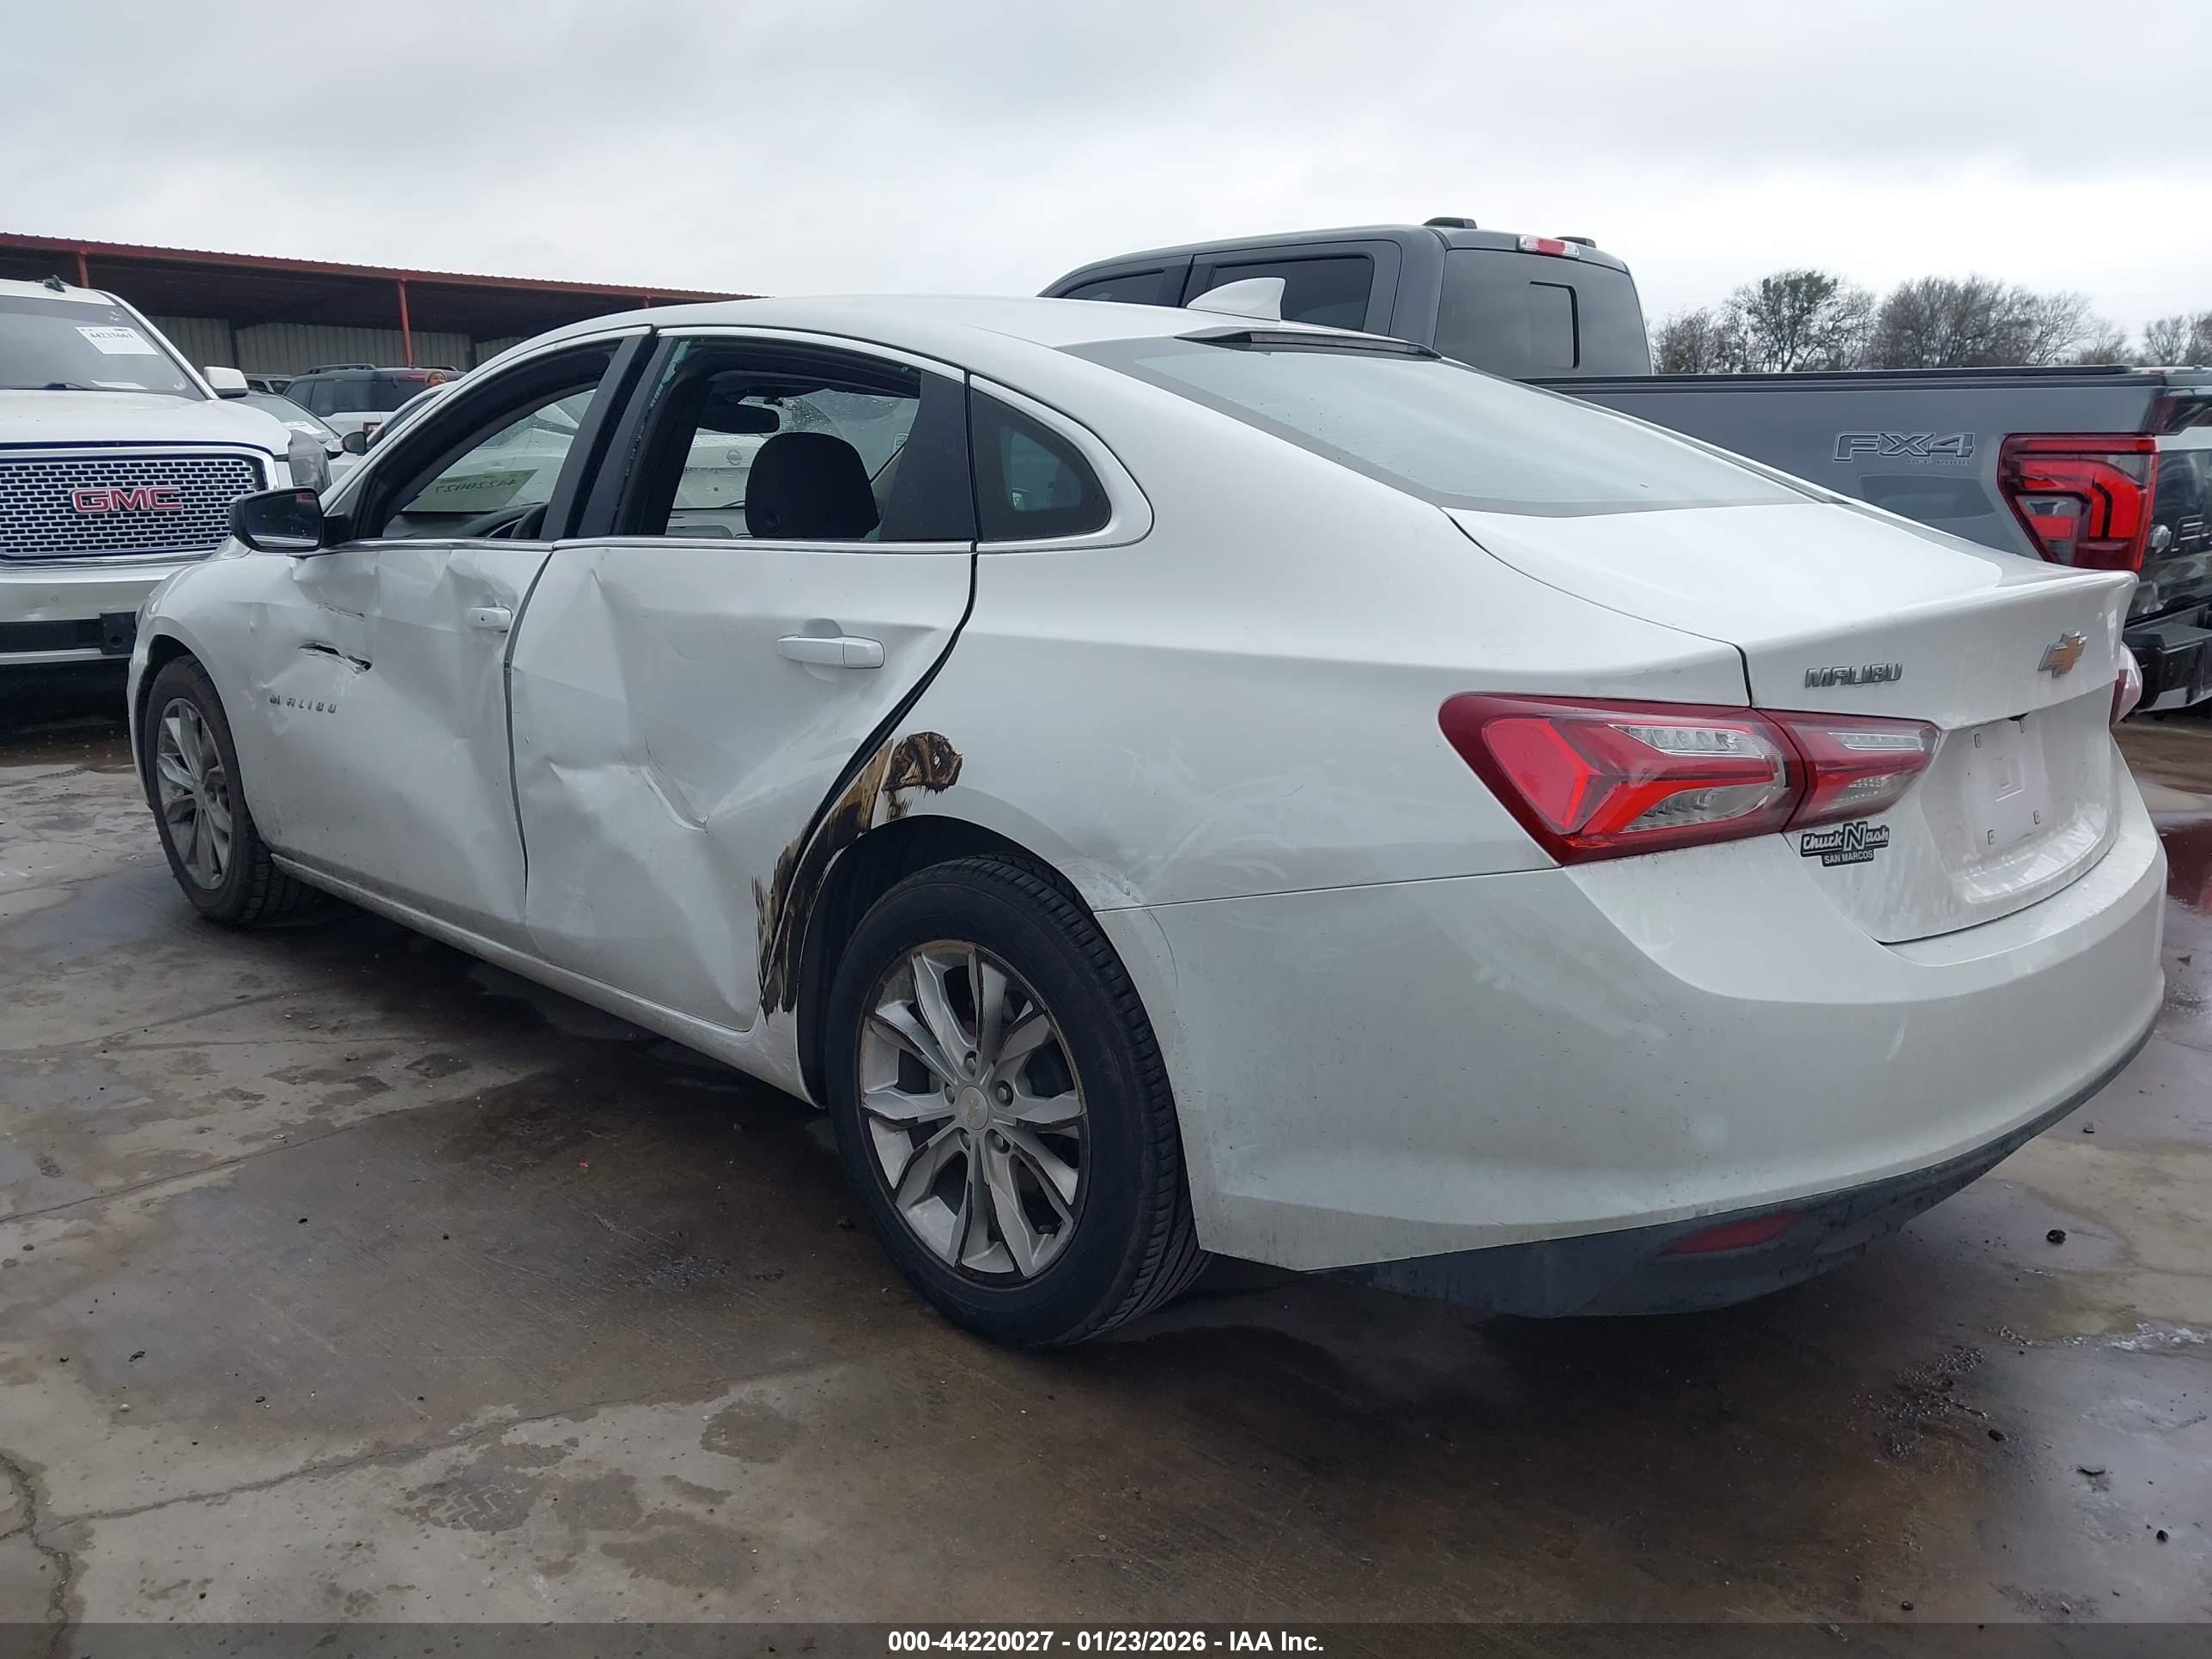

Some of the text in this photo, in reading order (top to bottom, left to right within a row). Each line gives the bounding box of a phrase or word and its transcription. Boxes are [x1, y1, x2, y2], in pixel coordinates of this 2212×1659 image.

[1833, 431, 1975, 462] FX4
[72, 486, 184, 514] GMC
[1804, 663, 1904, 689] MALIBU
[269, 694, 337, 714] MALIBU
[1802, 824, 1889, 852] Chuck Nash
[1824, 849, 1874, 865] SAN MARCOS
